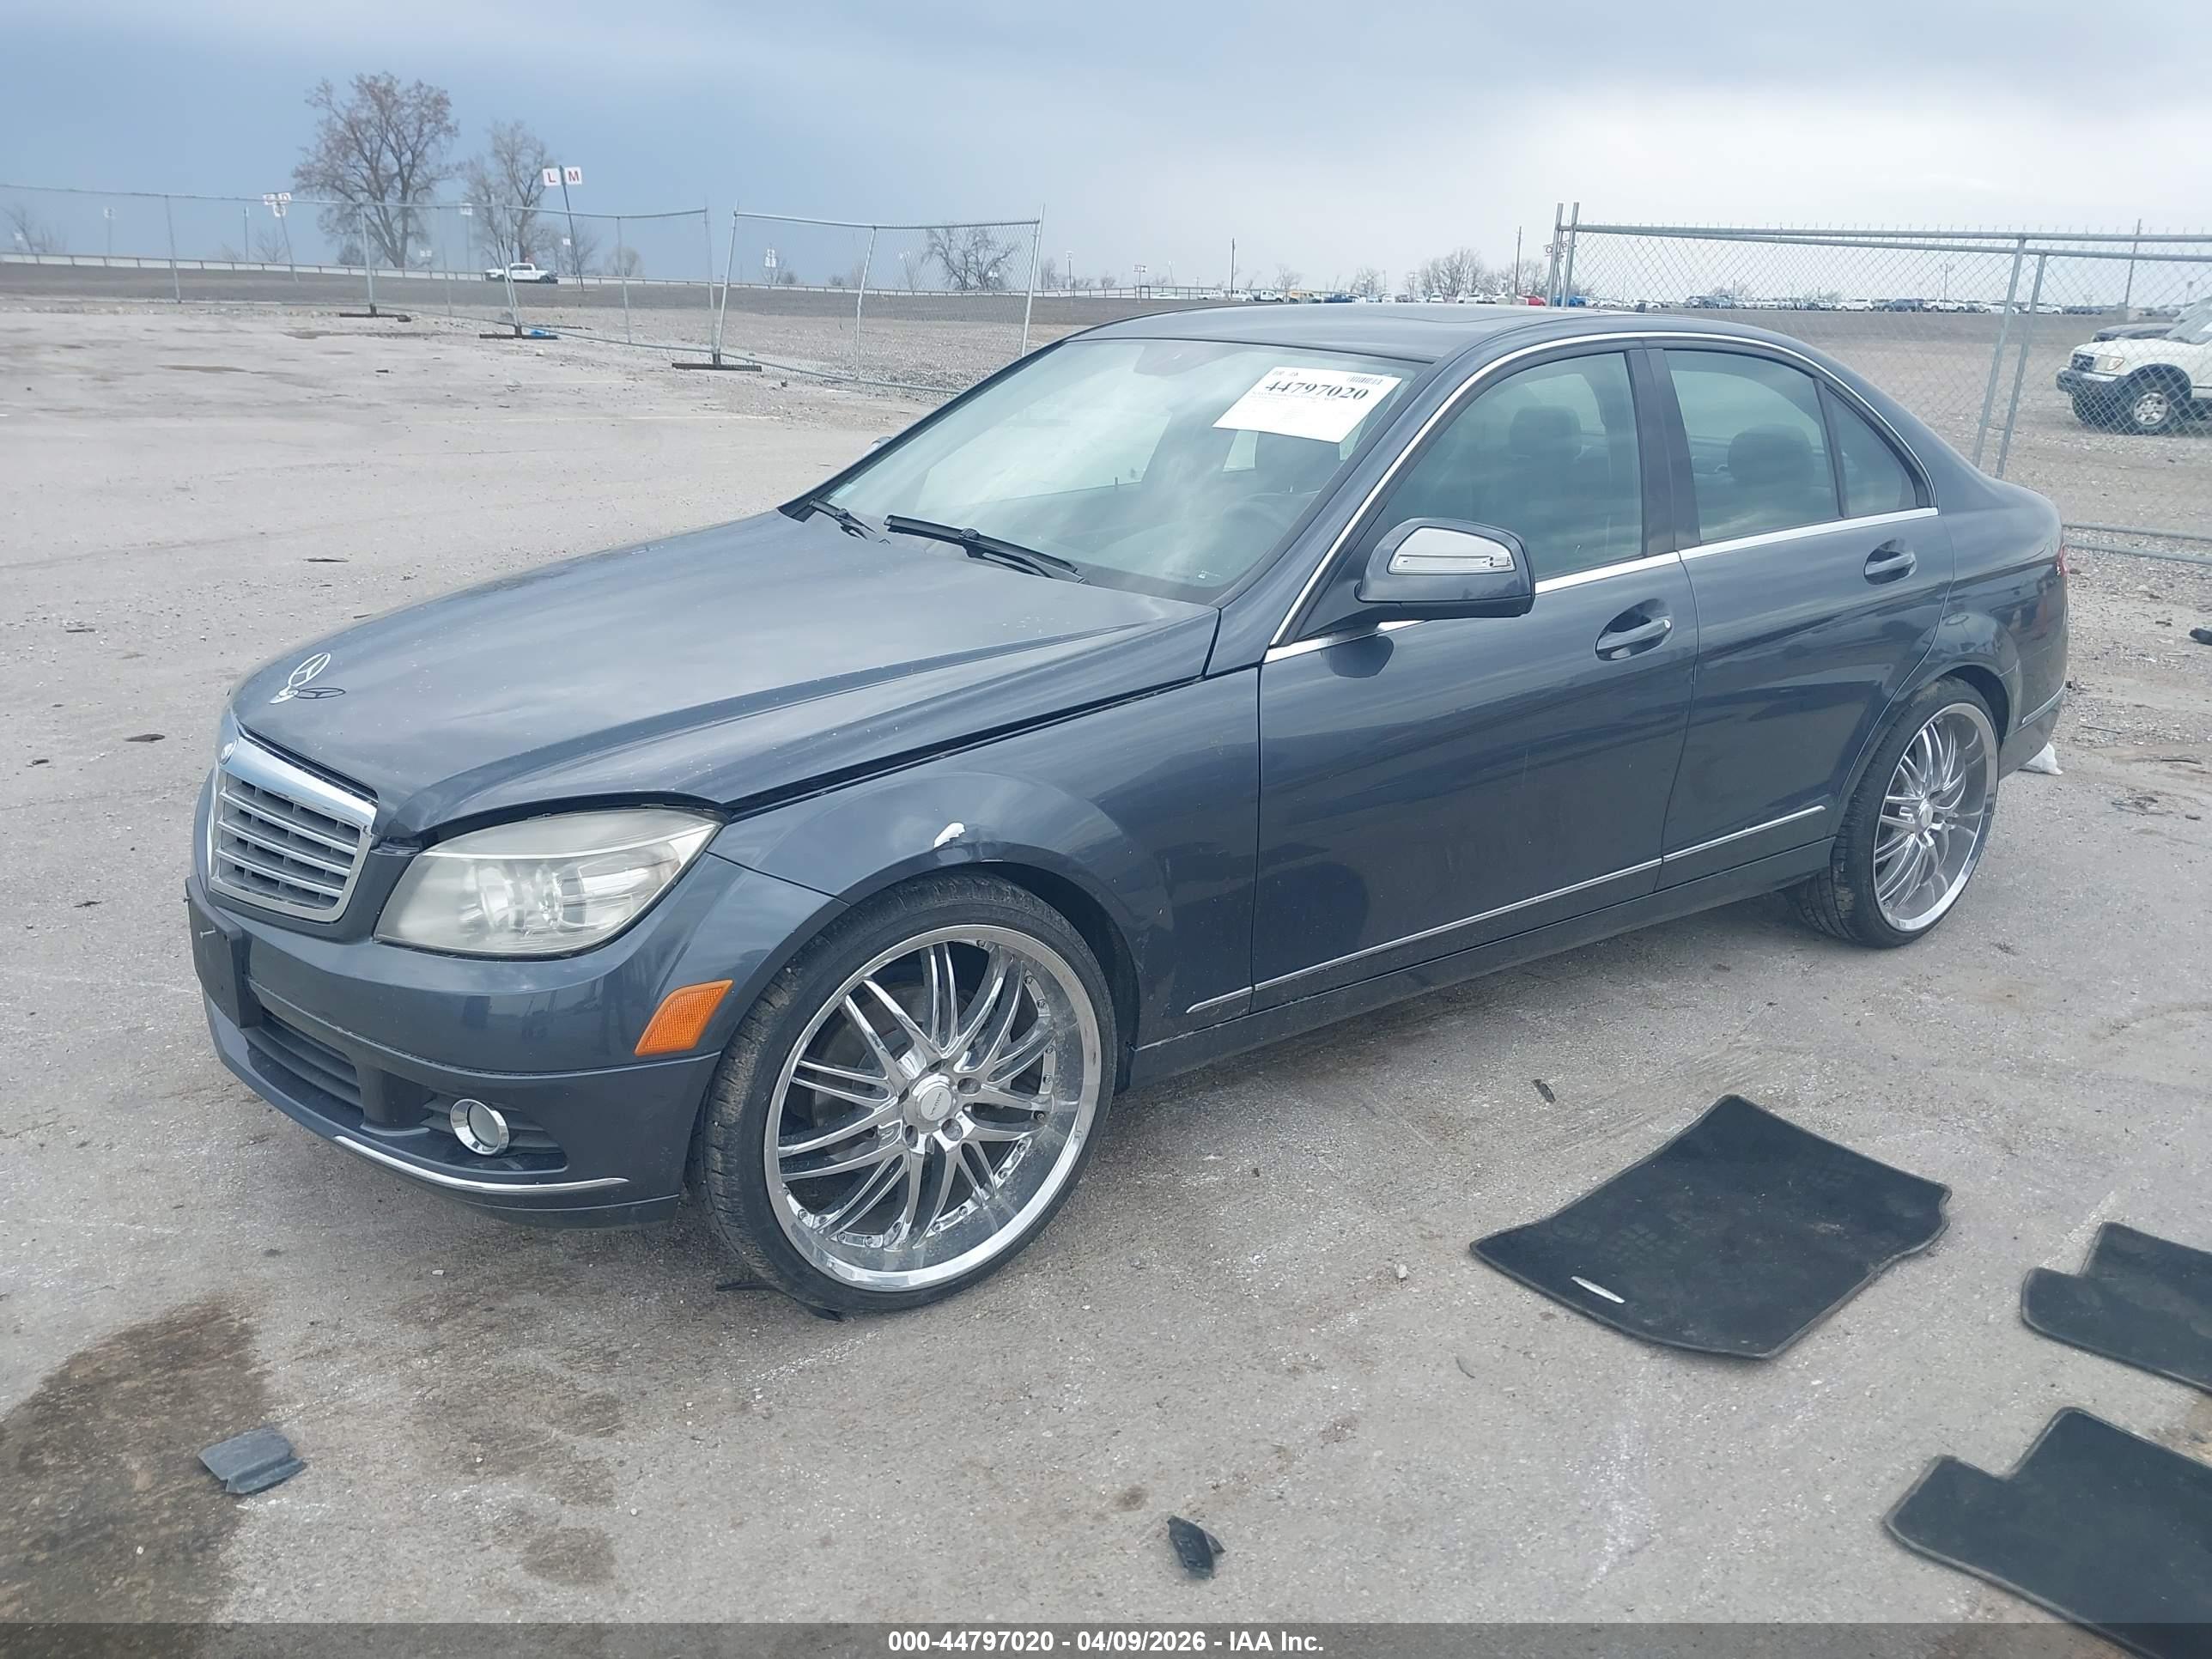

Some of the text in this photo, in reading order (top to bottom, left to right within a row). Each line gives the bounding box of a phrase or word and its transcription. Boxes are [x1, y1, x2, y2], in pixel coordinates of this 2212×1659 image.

[547, 171, 580, 183] L M
[1265, 380, 1370, 400] 44797020
